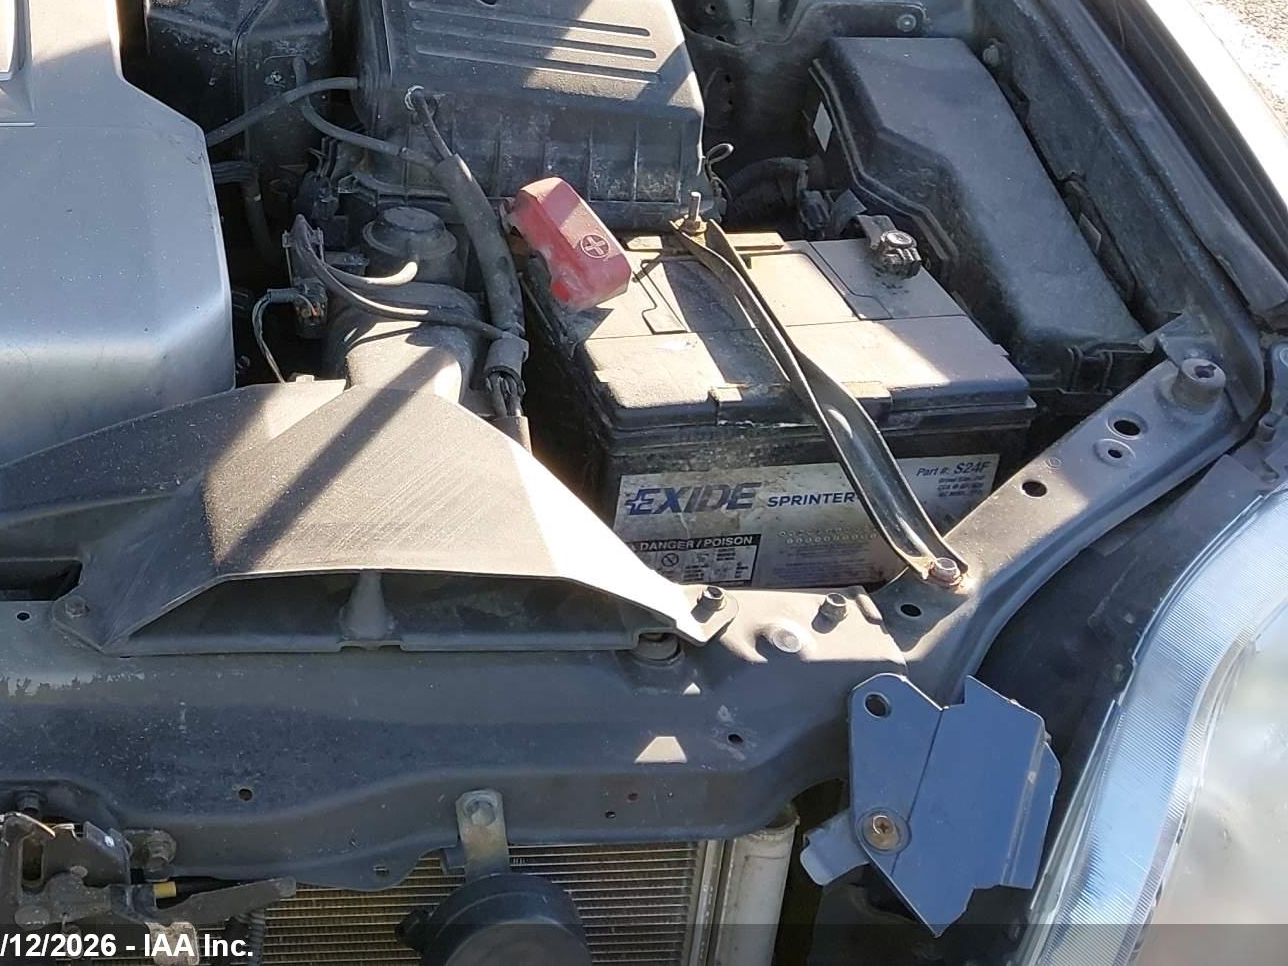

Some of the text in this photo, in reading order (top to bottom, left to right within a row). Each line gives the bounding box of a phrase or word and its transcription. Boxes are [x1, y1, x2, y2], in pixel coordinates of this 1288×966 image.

[916, 467, 939, 476] Part
[953, 461, 991, 474] S24F
[625, 482, 856, 516] EXIDE SPRINTER
